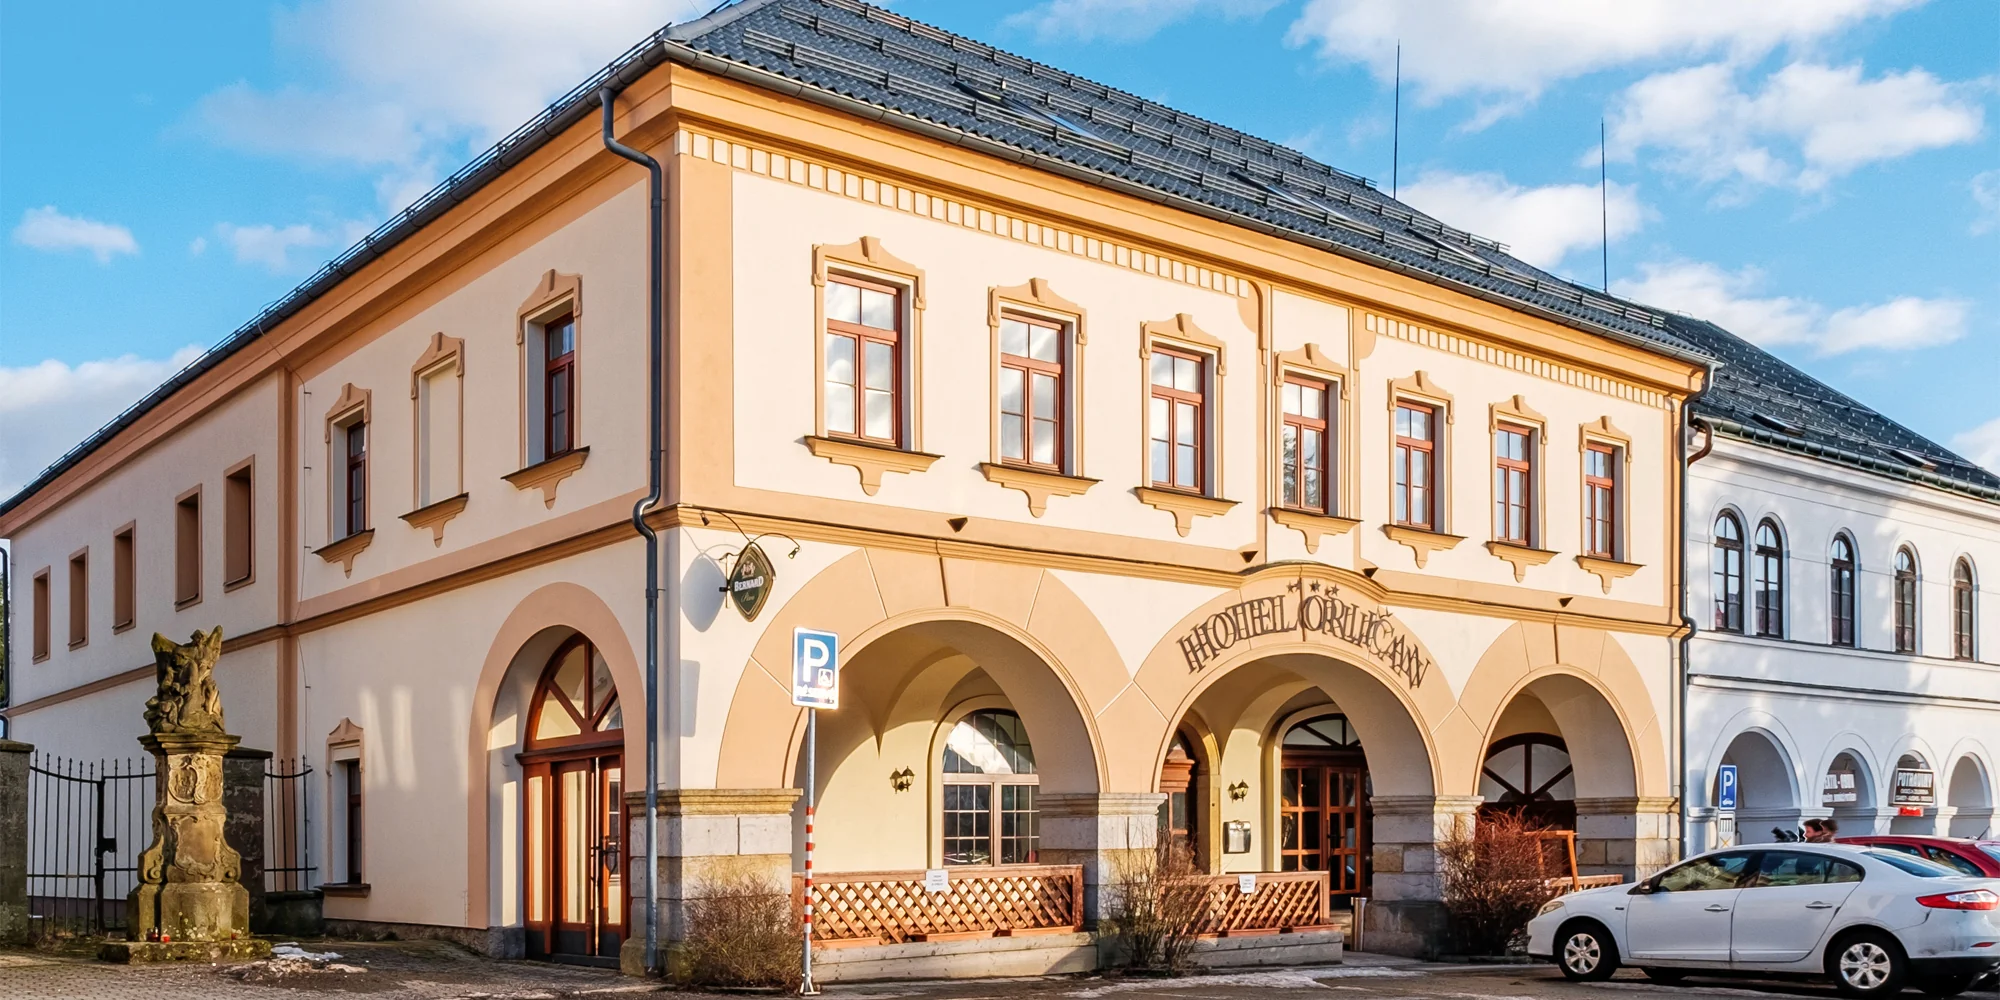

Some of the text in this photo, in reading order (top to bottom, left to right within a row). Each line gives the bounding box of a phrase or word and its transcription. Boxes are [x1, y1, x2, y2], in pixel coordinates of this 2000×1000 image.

[734, 576, 764, 592] BERNARD
[1176, 594, 1432, 690] HOTEL ORLIČAN
[803, 638, 829, 683] P
[1723, 770, 1734, 797] P
